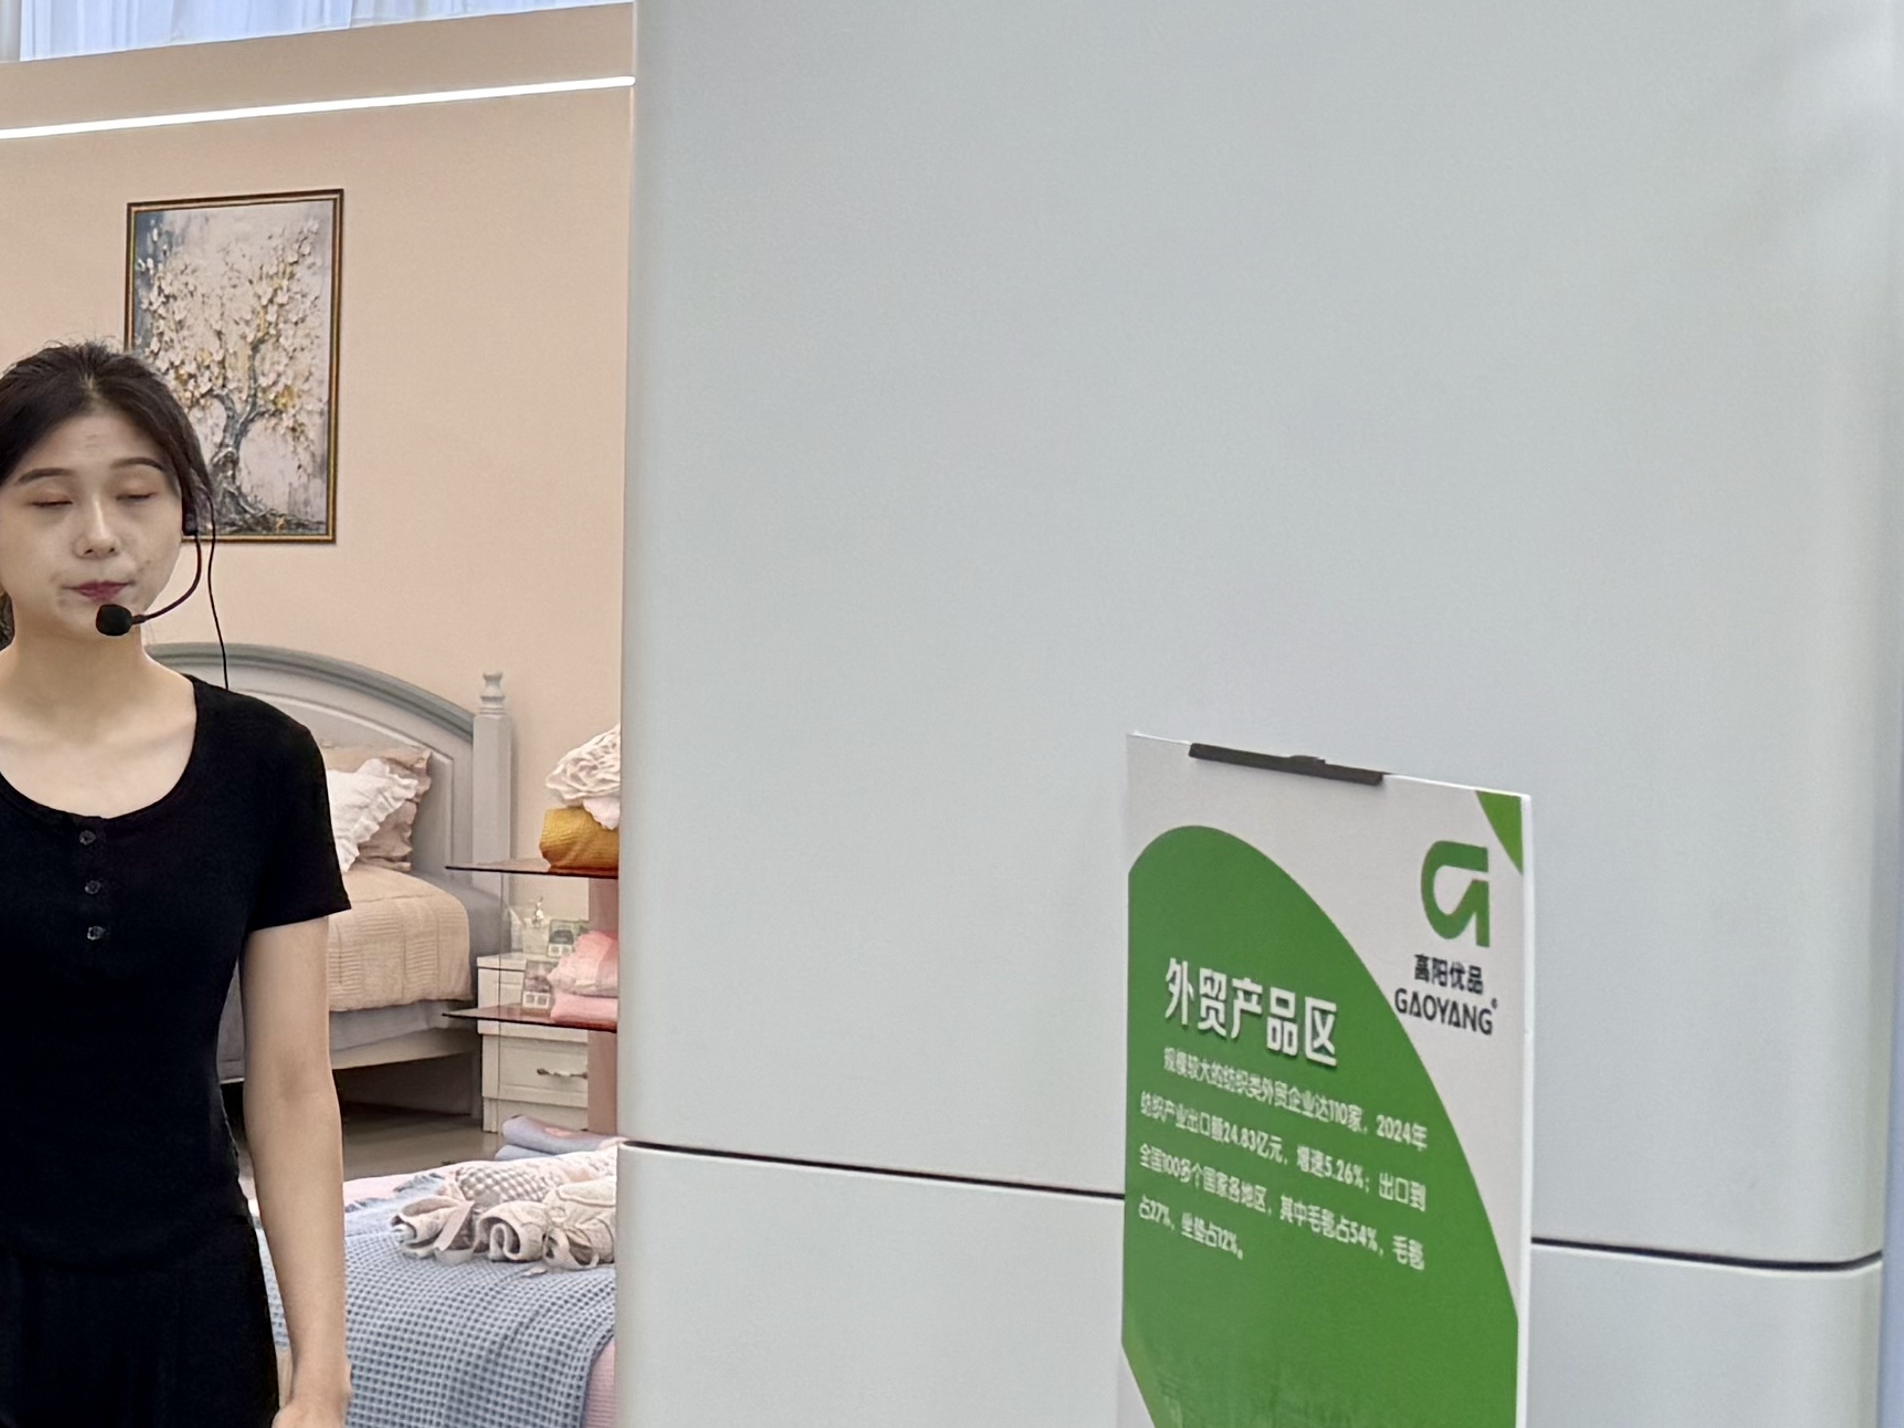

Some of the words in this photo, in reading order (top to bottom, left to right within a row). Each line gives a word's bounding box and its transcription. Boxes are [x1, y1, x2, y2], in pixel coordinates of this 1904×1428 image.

[1414, 954, 1483, 995] 高阳优品
[1164, 957, 1338, 1066] 外贸产品区
[1394, 987, 1493, 1036] GAOYANG
